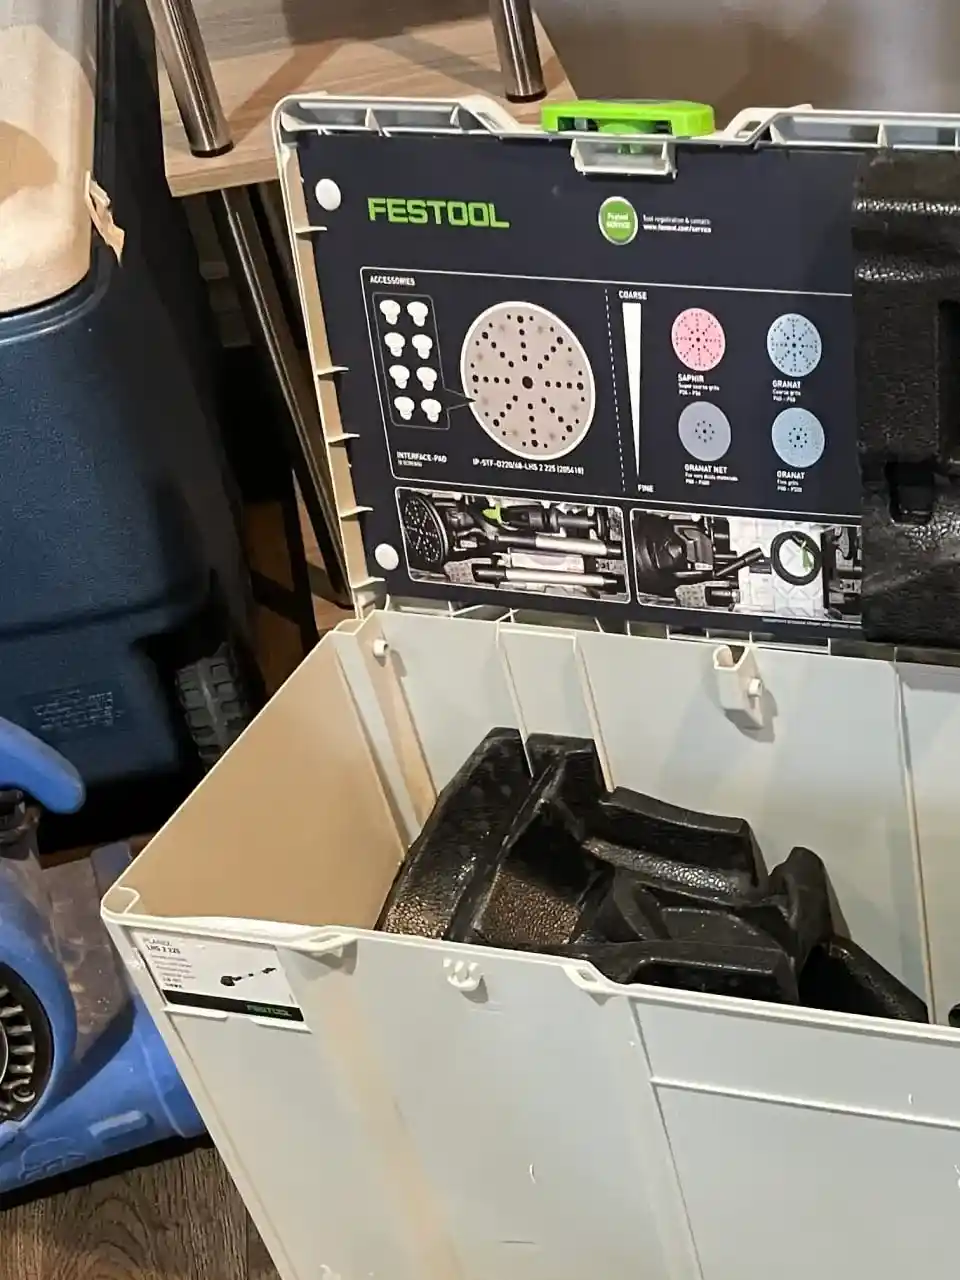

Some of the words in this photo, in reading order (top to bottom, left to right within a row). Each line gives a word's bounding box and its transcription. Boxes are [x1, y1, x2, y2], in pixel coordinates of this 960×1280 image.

[368, 197, 510, 229] FESTOOL
[370, 275, 416, 286] ACCESSORIES
[618, 290, 647, 300] COARSE
[772, 379, 801, 389] GRANAT
[396, 451, 448, 463] INTERFACE-PAD
[684, 463, 712, 473] GRANAT
[713, 465, 728, 474] NET
[776, 470, 805, 480] GRANAT
[637, 484, 654, 493] FINE
